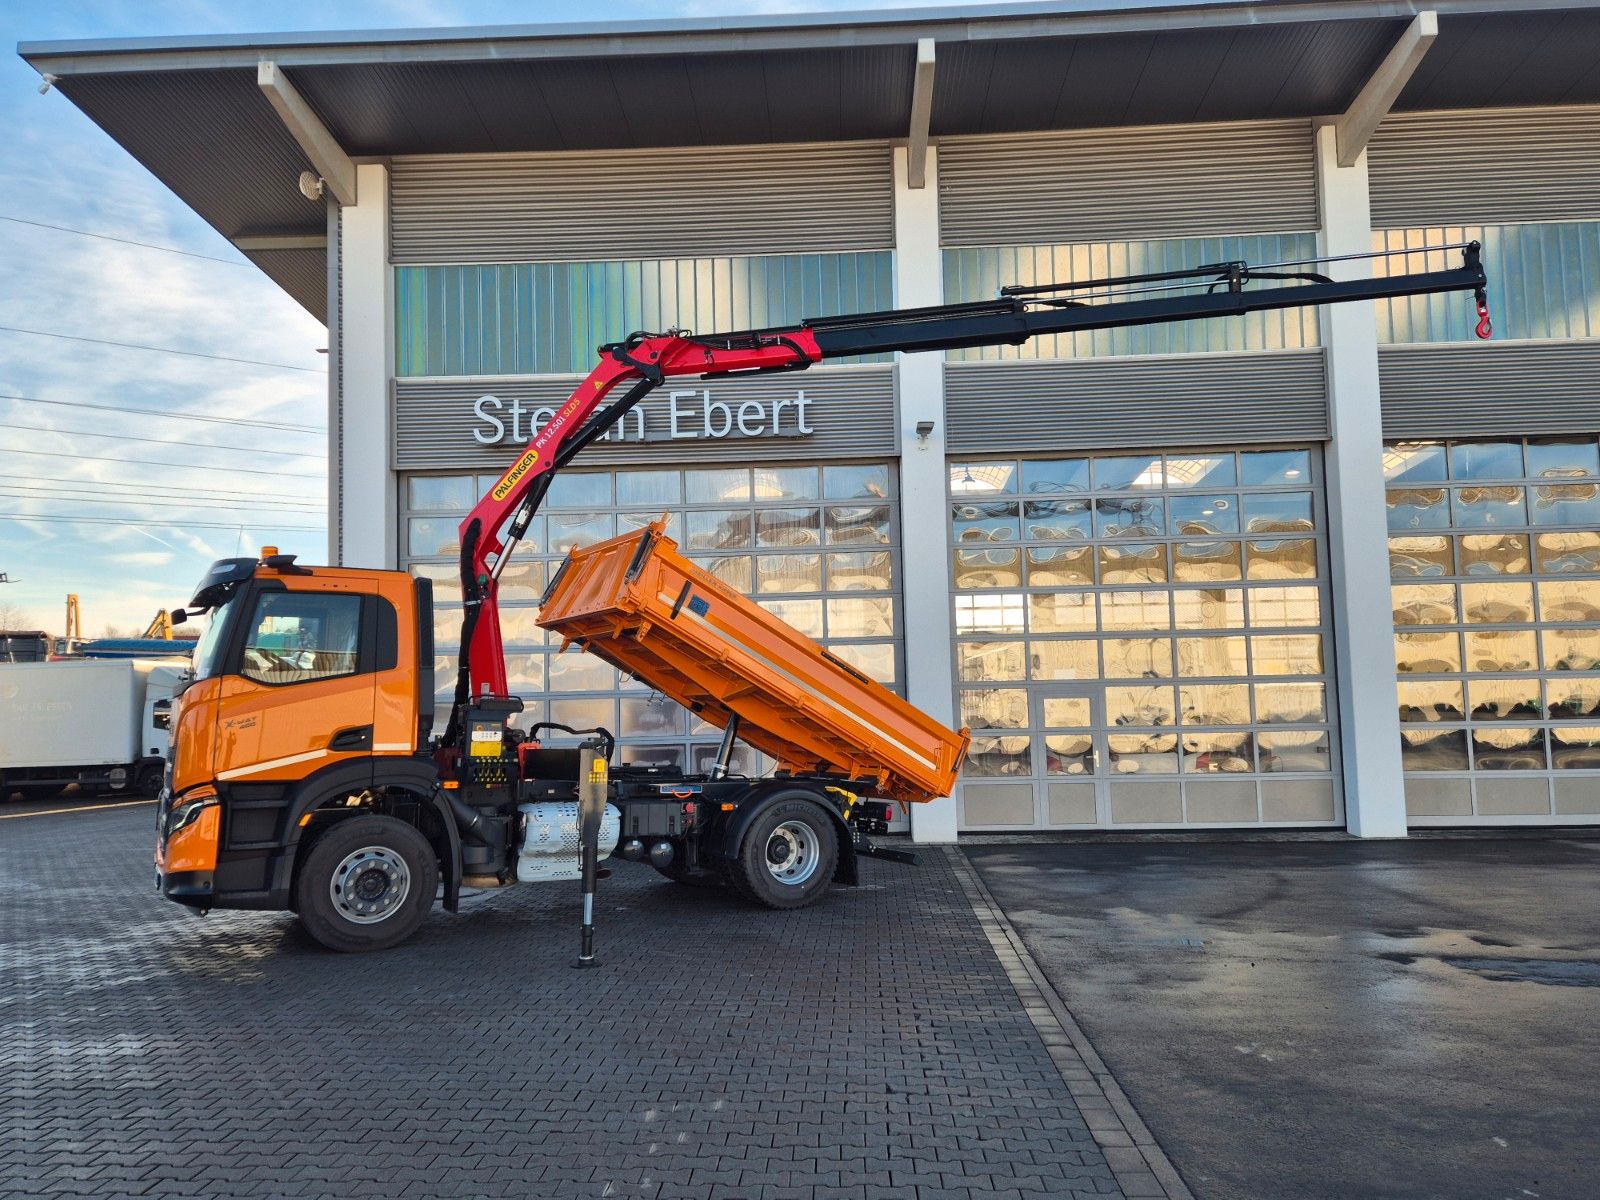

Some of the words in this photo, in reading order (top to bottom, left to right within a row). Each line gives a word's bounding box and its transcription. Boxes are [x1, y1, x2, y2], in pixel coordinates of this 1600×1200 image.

[473, 395, 645, 444] Sten
[670, 390, 814, 438] Ebert
[535, 437, 549, 449] PK
[545, 416, 566, 440] 12.501
[564, 398, 581, 418] SLD5
[495, 453, 536, 498] PALFINGER
